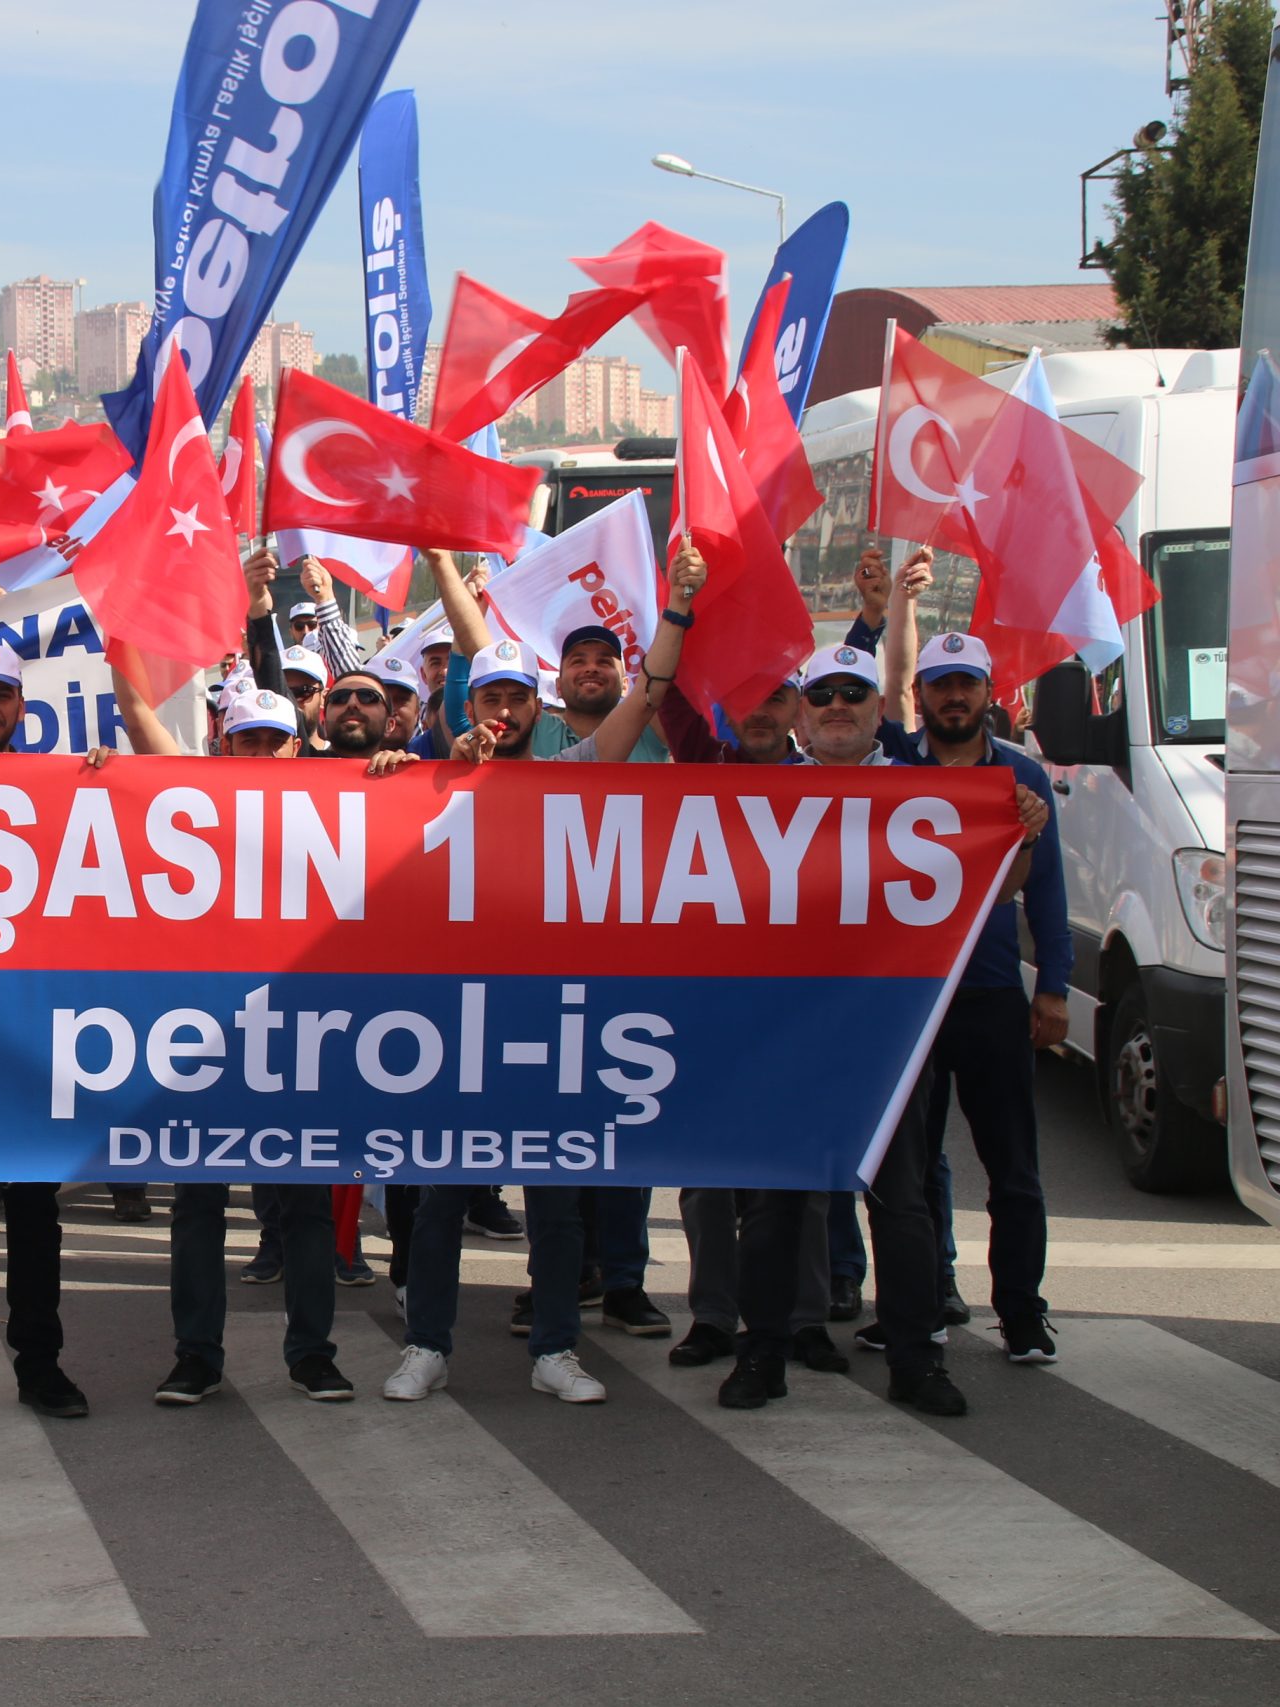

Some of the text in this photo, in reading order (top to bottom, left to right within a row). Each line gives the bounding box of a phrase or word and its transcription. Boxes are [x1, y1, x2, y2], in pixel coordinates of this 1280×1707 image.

[366, 197, 405, 420] rol-iş
[397, 239, 408, 300] Sendikası
[402, 347, 415, 385] Lastik
[568, 561, 646, 683] petro
[423, 791, 475, 922] 1
[543, 793, 963, 926] MAYIS
[51, 982, 677, 1125] petrol-iş
[108, 1119, 615, 1178] DÜZCE ŞUBESİ
